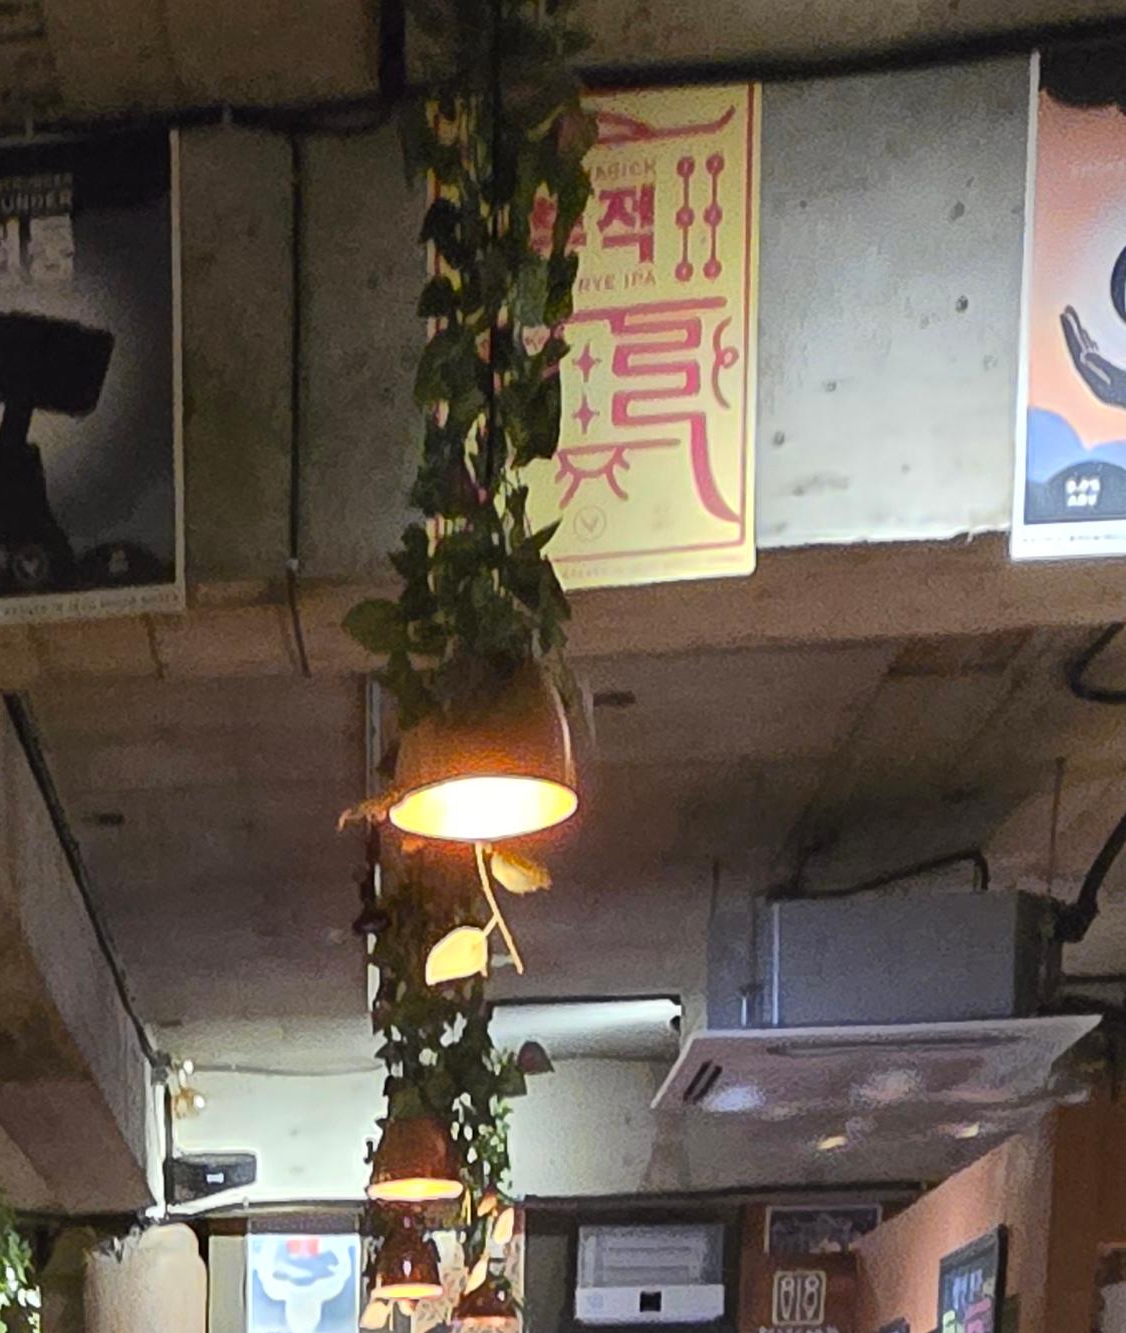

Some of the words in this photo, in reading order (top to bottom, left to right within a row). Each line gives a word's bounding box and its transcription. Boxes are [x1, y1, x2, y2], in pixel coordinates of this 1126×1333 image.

[589, 156, 656, 181] AGICK
[578, 272, 613, 292] RYE
[624, 268, 656, 289] IPA
